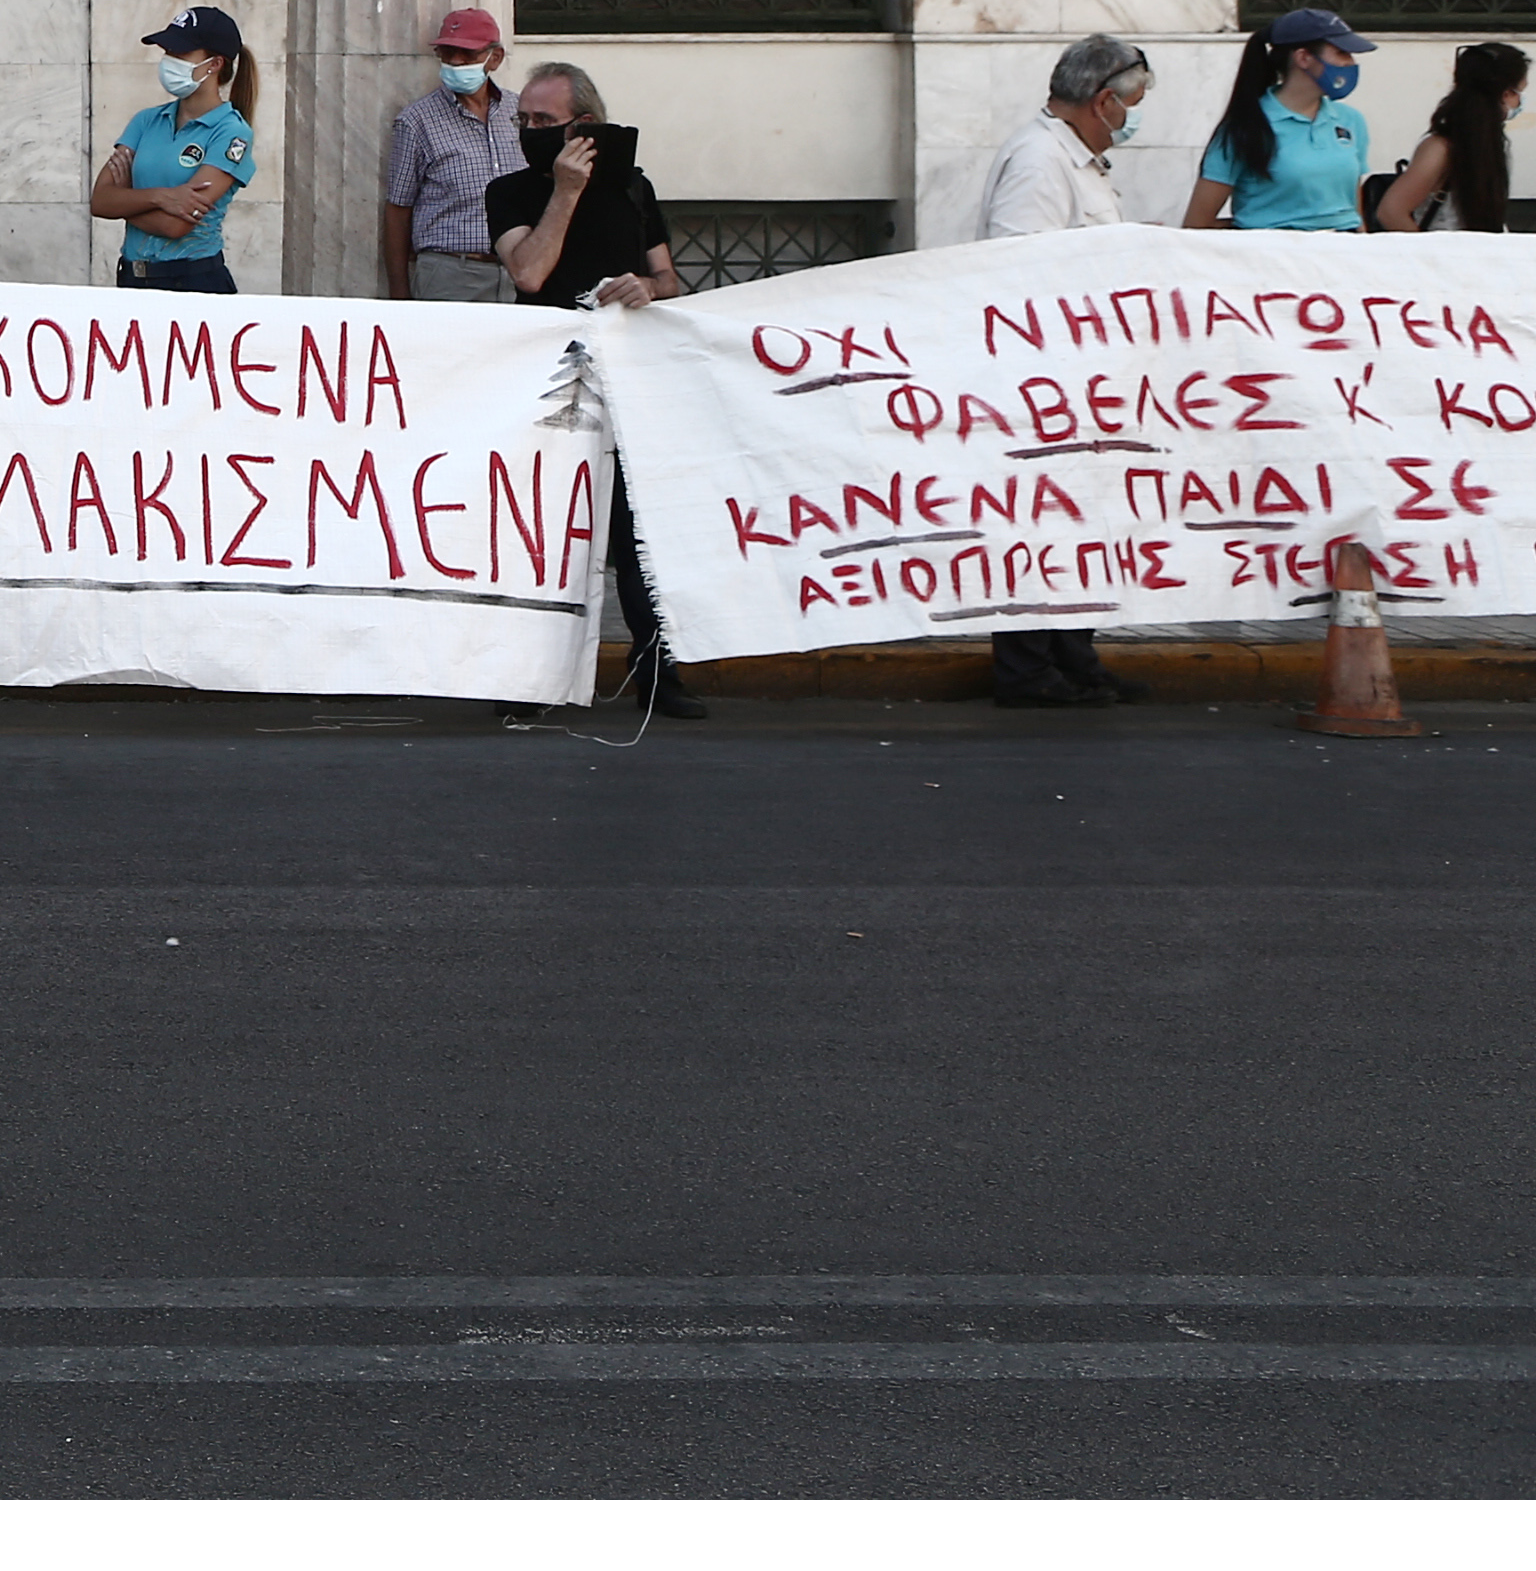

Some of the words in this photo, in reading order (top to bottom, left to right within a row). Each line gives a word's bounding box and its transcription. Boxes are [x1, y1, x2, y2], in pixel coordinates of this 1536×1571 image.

[752, 323, 911, 376] ΟΧΙ
[887, 371, 1309, 444] ΦΑΒΕΛΕΣ
[1435, 377, 1536, 434] ΚΟ
[725, 471, 1086, 562] ΚΑΝΕΝΑ
[1126, 462, 1332, 523] ΠΑΙΔΙ
[1386, 457, 1500, 521] ΣΕ
[799, 536, 1187, 618] ΑΞΙΟΠΡΕΠΗΣ
